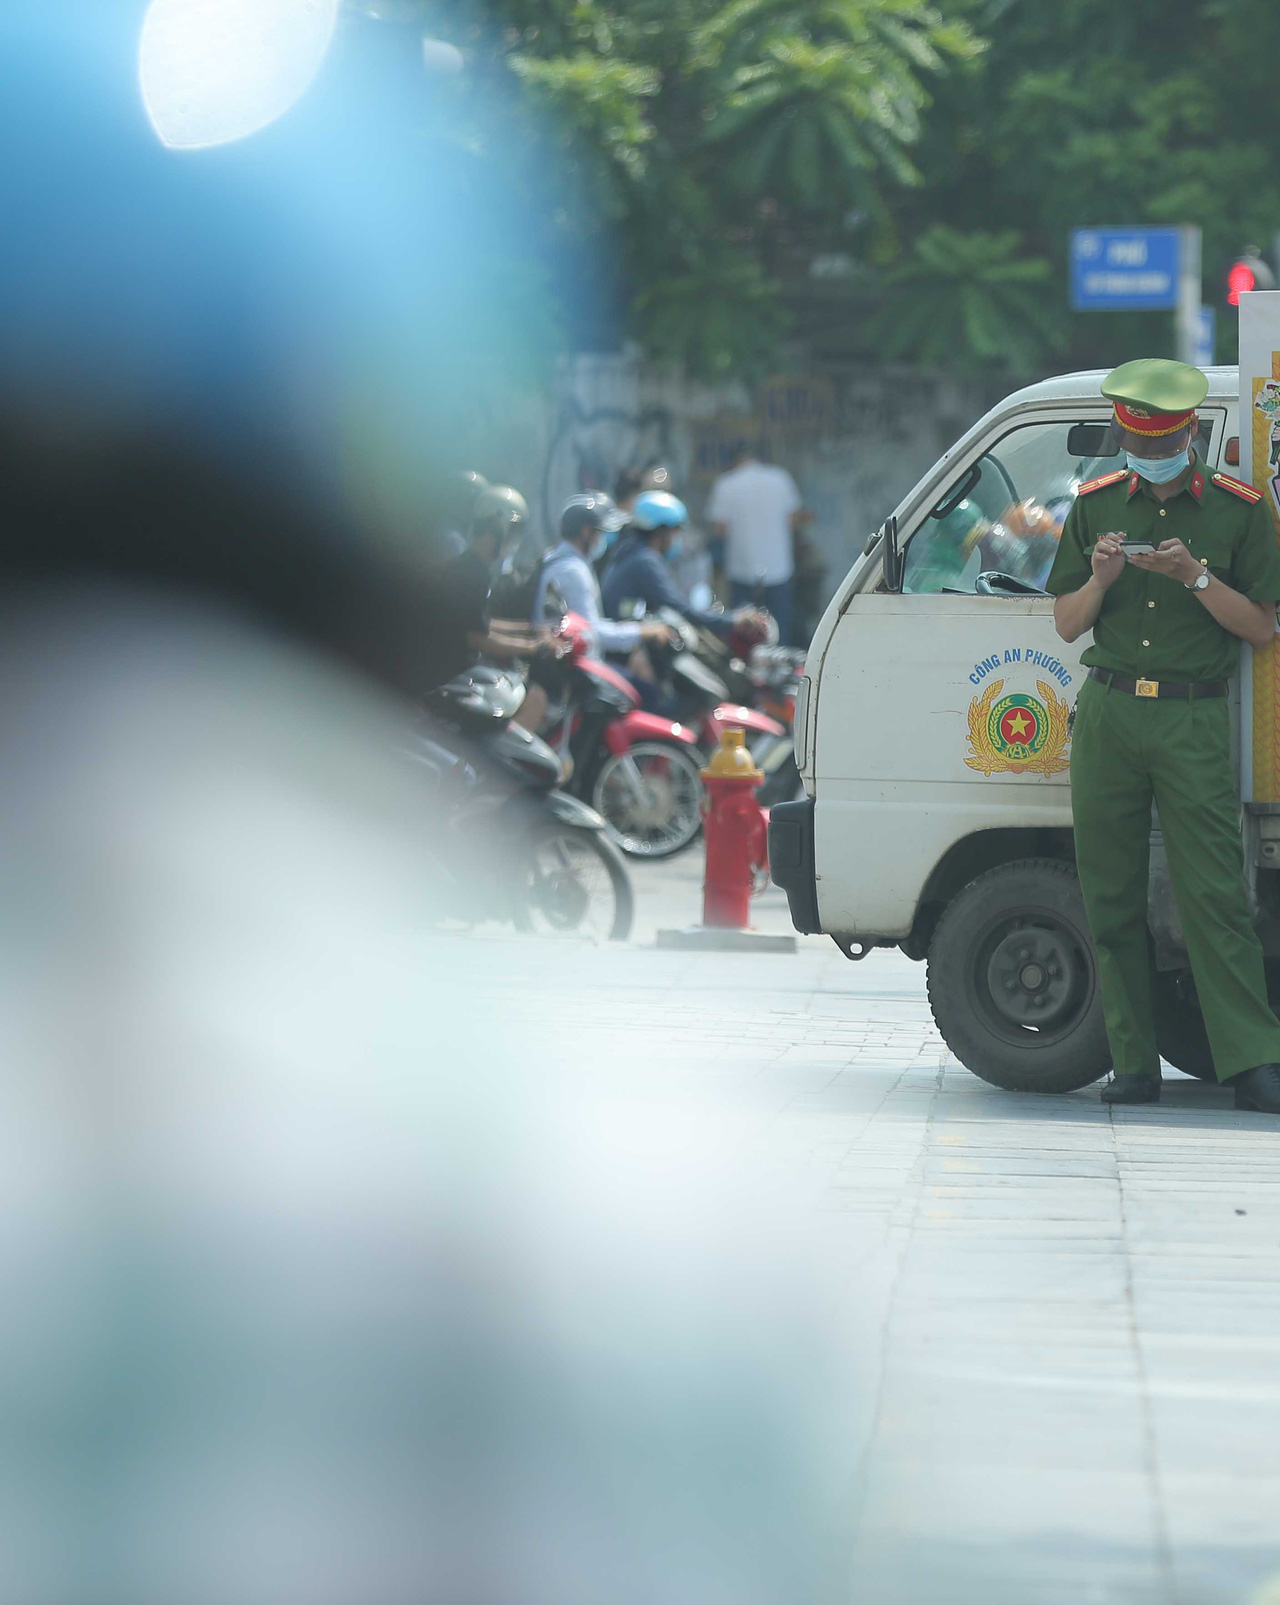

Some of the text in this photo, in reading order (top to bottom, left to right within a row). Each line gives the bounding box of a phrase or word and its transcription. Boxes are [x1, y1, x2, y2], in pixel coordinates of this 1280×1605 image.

[968, 648, 1073, 688] CÔNG AN PHƯỜNG
